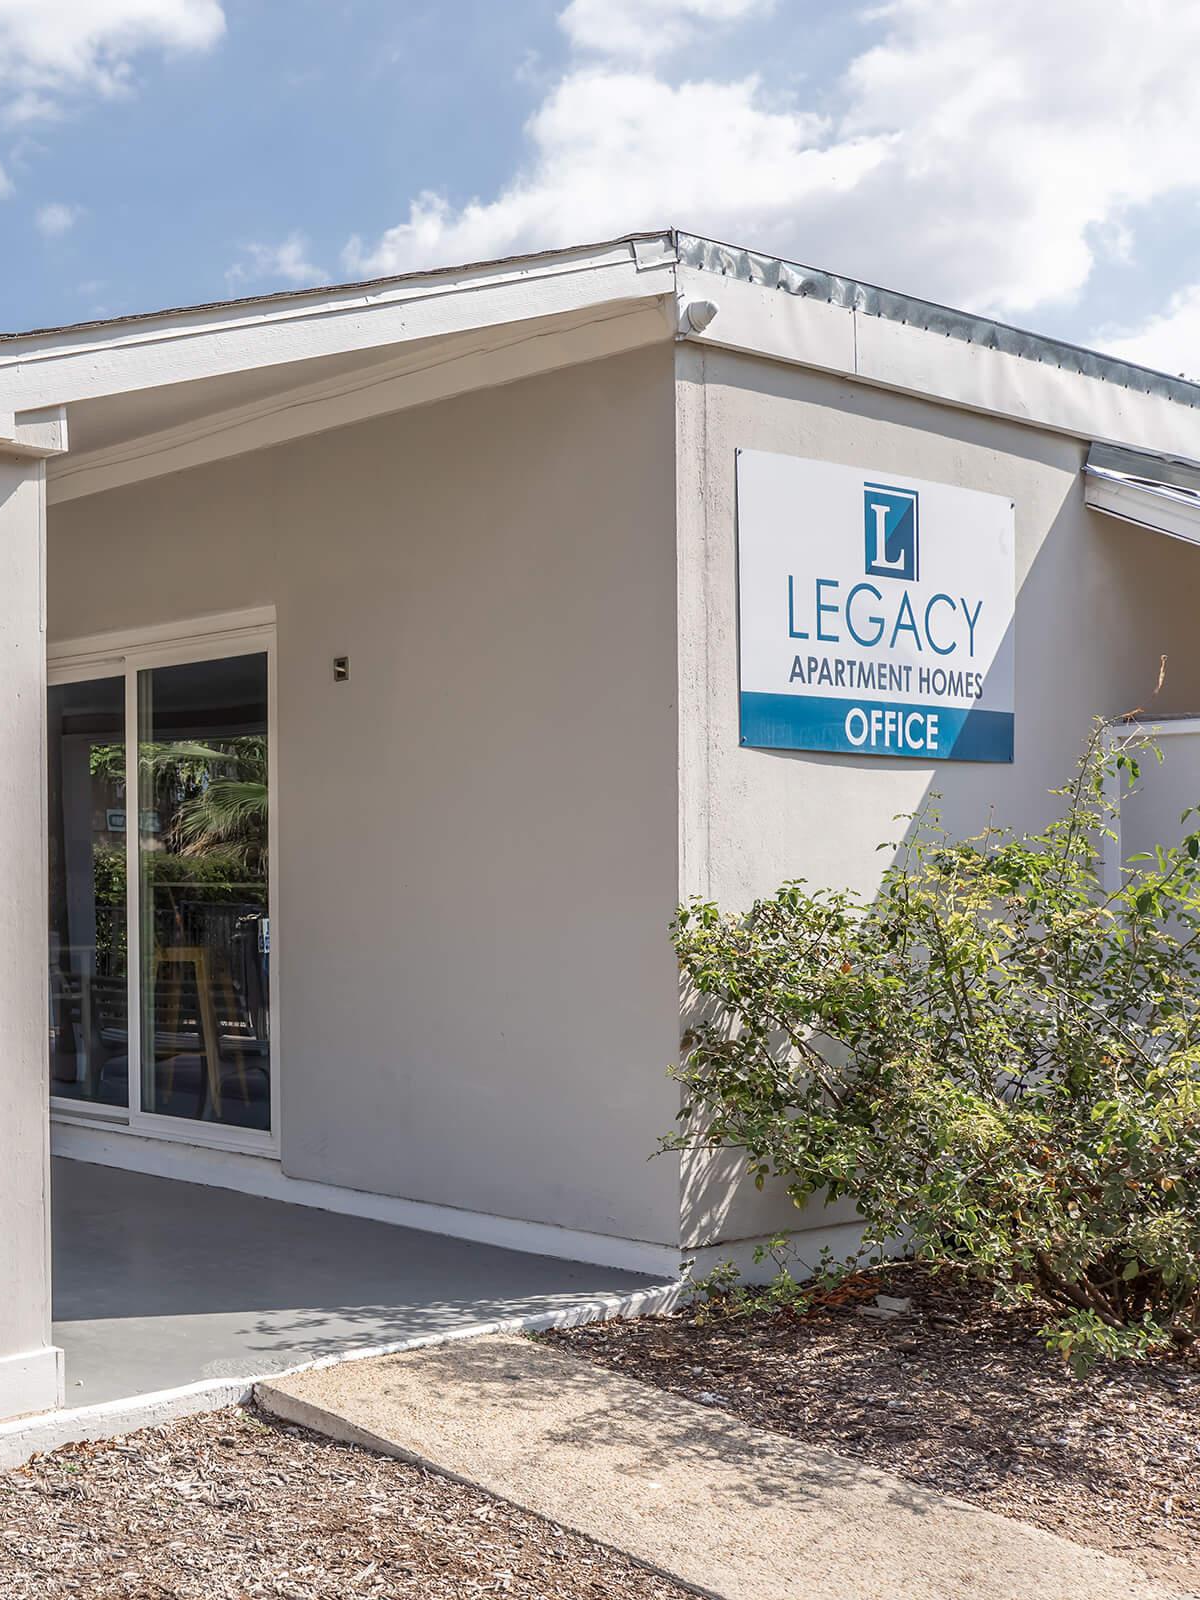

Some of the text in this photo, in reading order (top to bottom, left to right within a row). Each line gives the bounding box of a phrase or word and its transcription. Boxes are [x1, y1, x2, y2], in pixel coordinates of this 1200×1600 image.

[870, 503, 905, 570] L
[788, 575, 983, 657] LEGACY
[789, 655, 984, 699] APARTMENT HOMES
[845, 707, 939, 750] OFFICE
